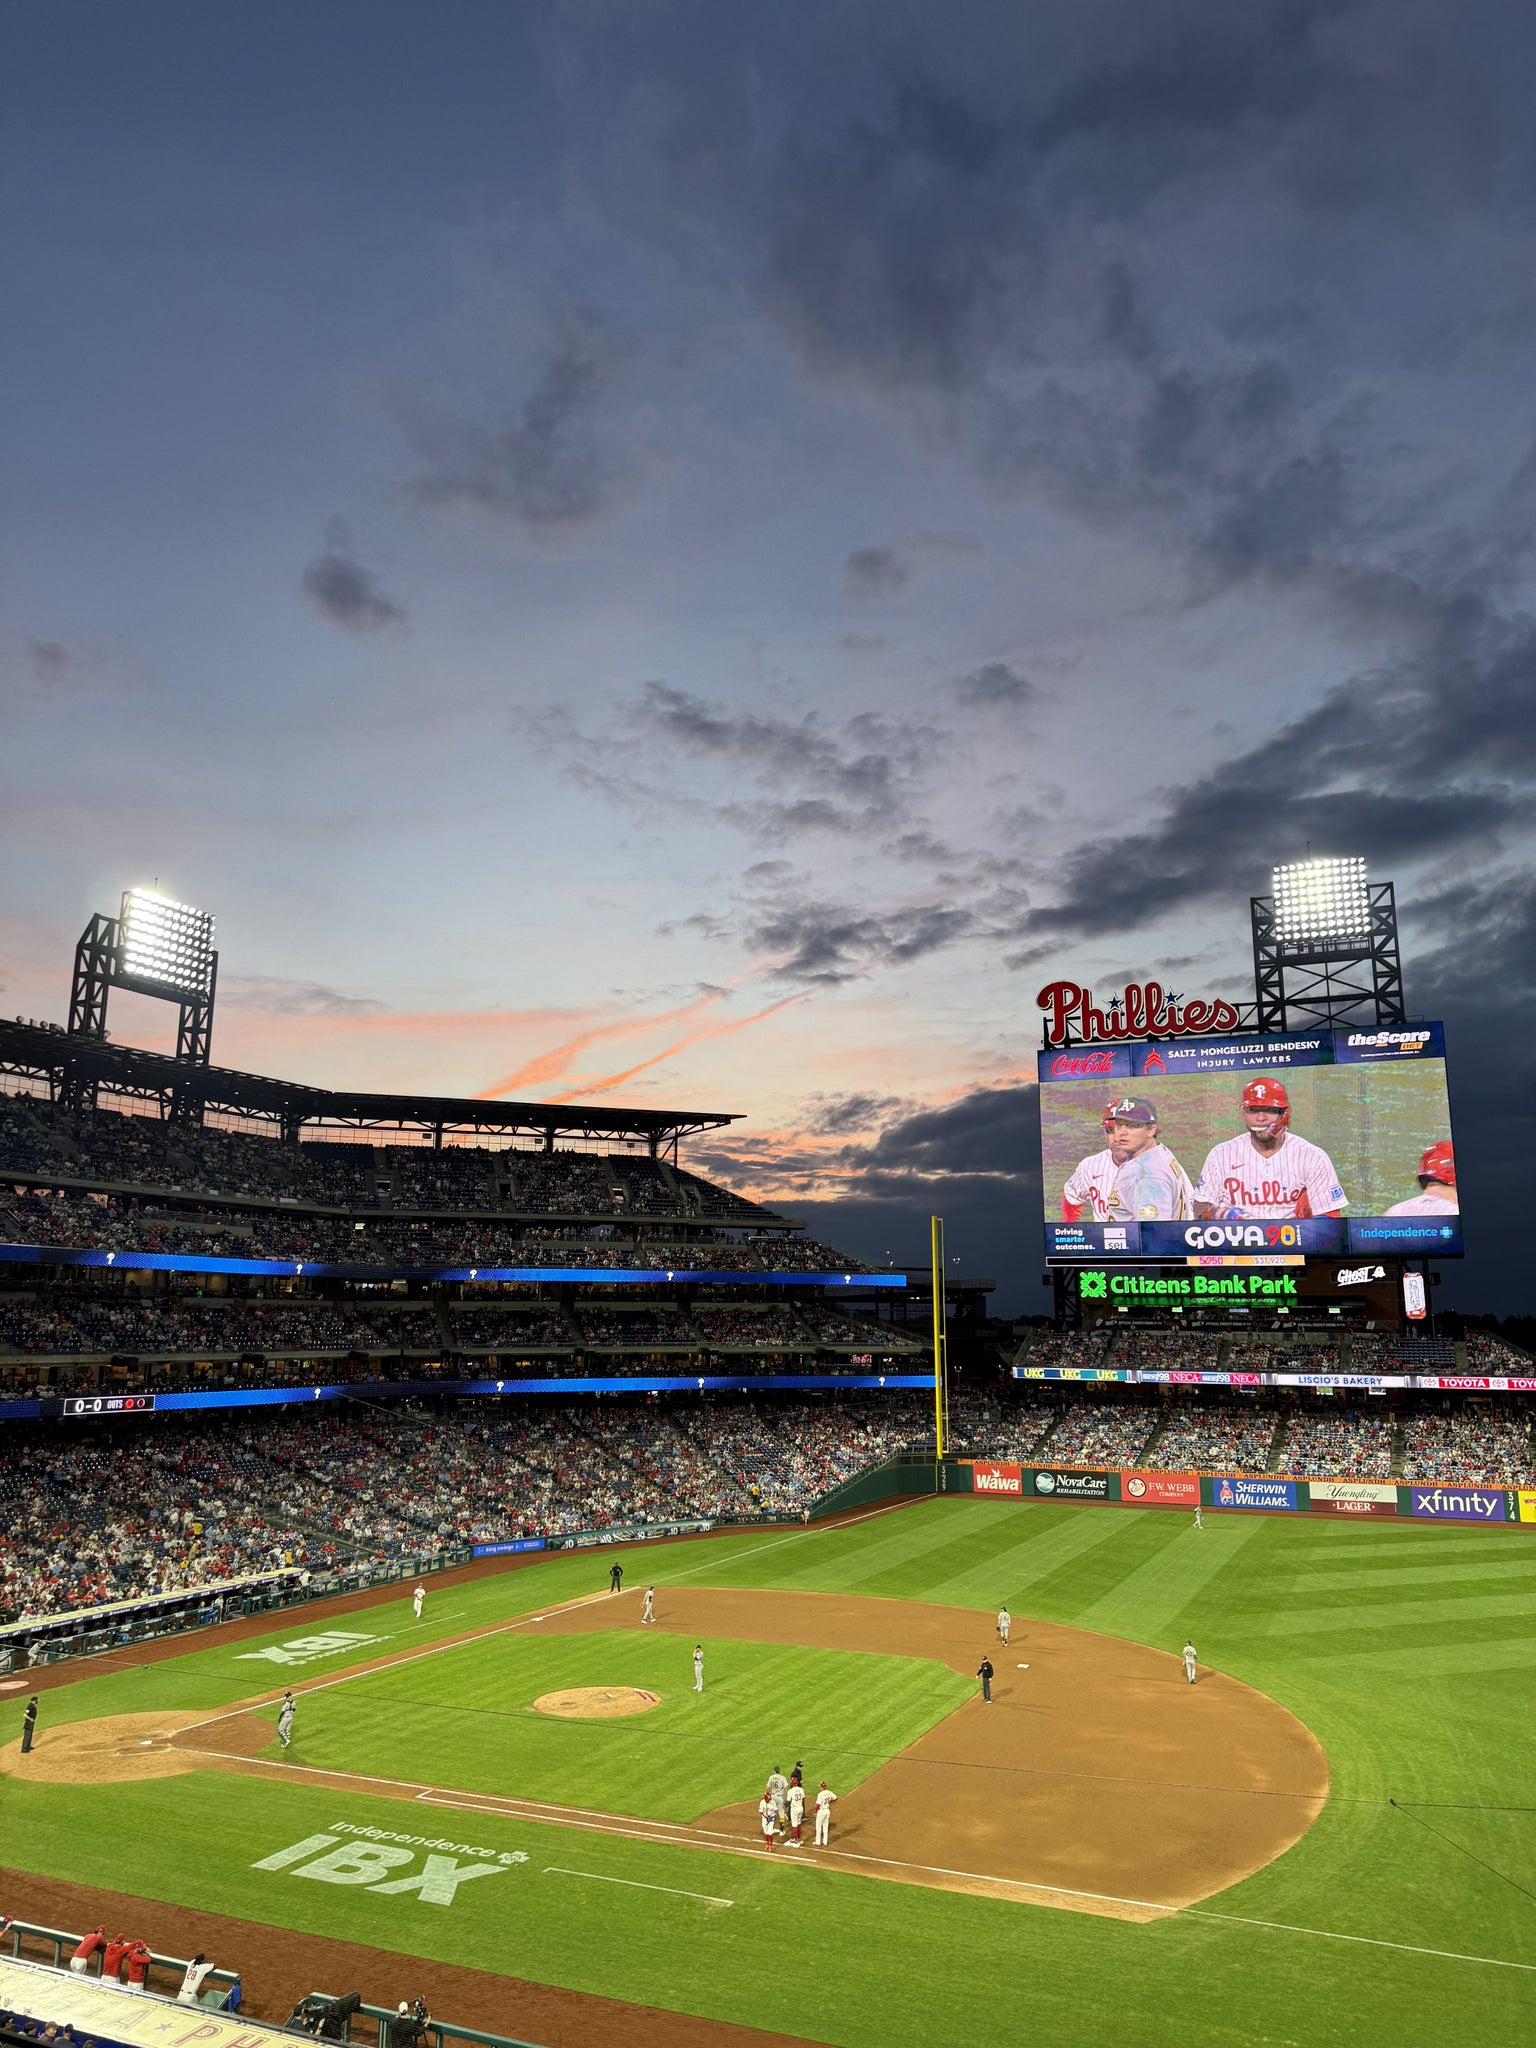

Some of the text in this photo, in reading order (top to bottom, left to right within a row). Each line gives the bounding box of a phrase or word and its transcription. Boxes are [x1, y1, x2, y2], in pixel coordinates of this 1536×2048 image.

[1037, 981, 1240, 1044] Phillies
[1348, 1031, 1430, 1046] theScore
[1168, 1041, 1320, 1059] SALTZ MONGELUZZI BENDESKY
[1051, 1051, 1116, 1077] Coca-Cola
[1198, 1055, 1291, 1068] INJURY LAWYERS
[1224, 1177, 1307, 1206] Phillie
[1055, 1228, 1083, 1236] Driving
[1185, 1225, 1295, 1249] GOYA 90
[1361, 1228, 1438, 1240] Independence
[1337, 1265, 1375, 1287] GHOST
[1110, 1275, 1296, 1294] Citizens Bank Park
[1024, 1368, 1045, 1378] UKG
[1060, 1369, 1081, 1379] UKG
[1097, 1370, 1118, 1380] UKG
[1173, 1373, 1199, 1382] NECA
[1233, 1374, 1260, 1384] NECA
[1298, 1376, 1382, 1385] LISCIO'S BAKERY
[1443, 1378, 1486, 1388] TOYOTA
[75, 1399, 102, 1412] 0-0
[976, 1474, 1019, 1491] Wawa
[1056, 1475, 1107, 1489] NovaCare
[1167, 1483, 1195, 1493] WEBB
[1236, 1481, 1287, 1495] SHERWIN
[1056, 1488, 1105, 1496] REHABILITATION
[1326, 1484, 1381, 1500] Yuengling
[1336, 1501, 1372, 1511] LAGER
[1417, 1489, 1498, 1517] xfinity
[1508, 1491, 1516, 1520] 374
[328, 1821, 496, 1858] Independence
[250, 1833, 510, 1906] IBX
